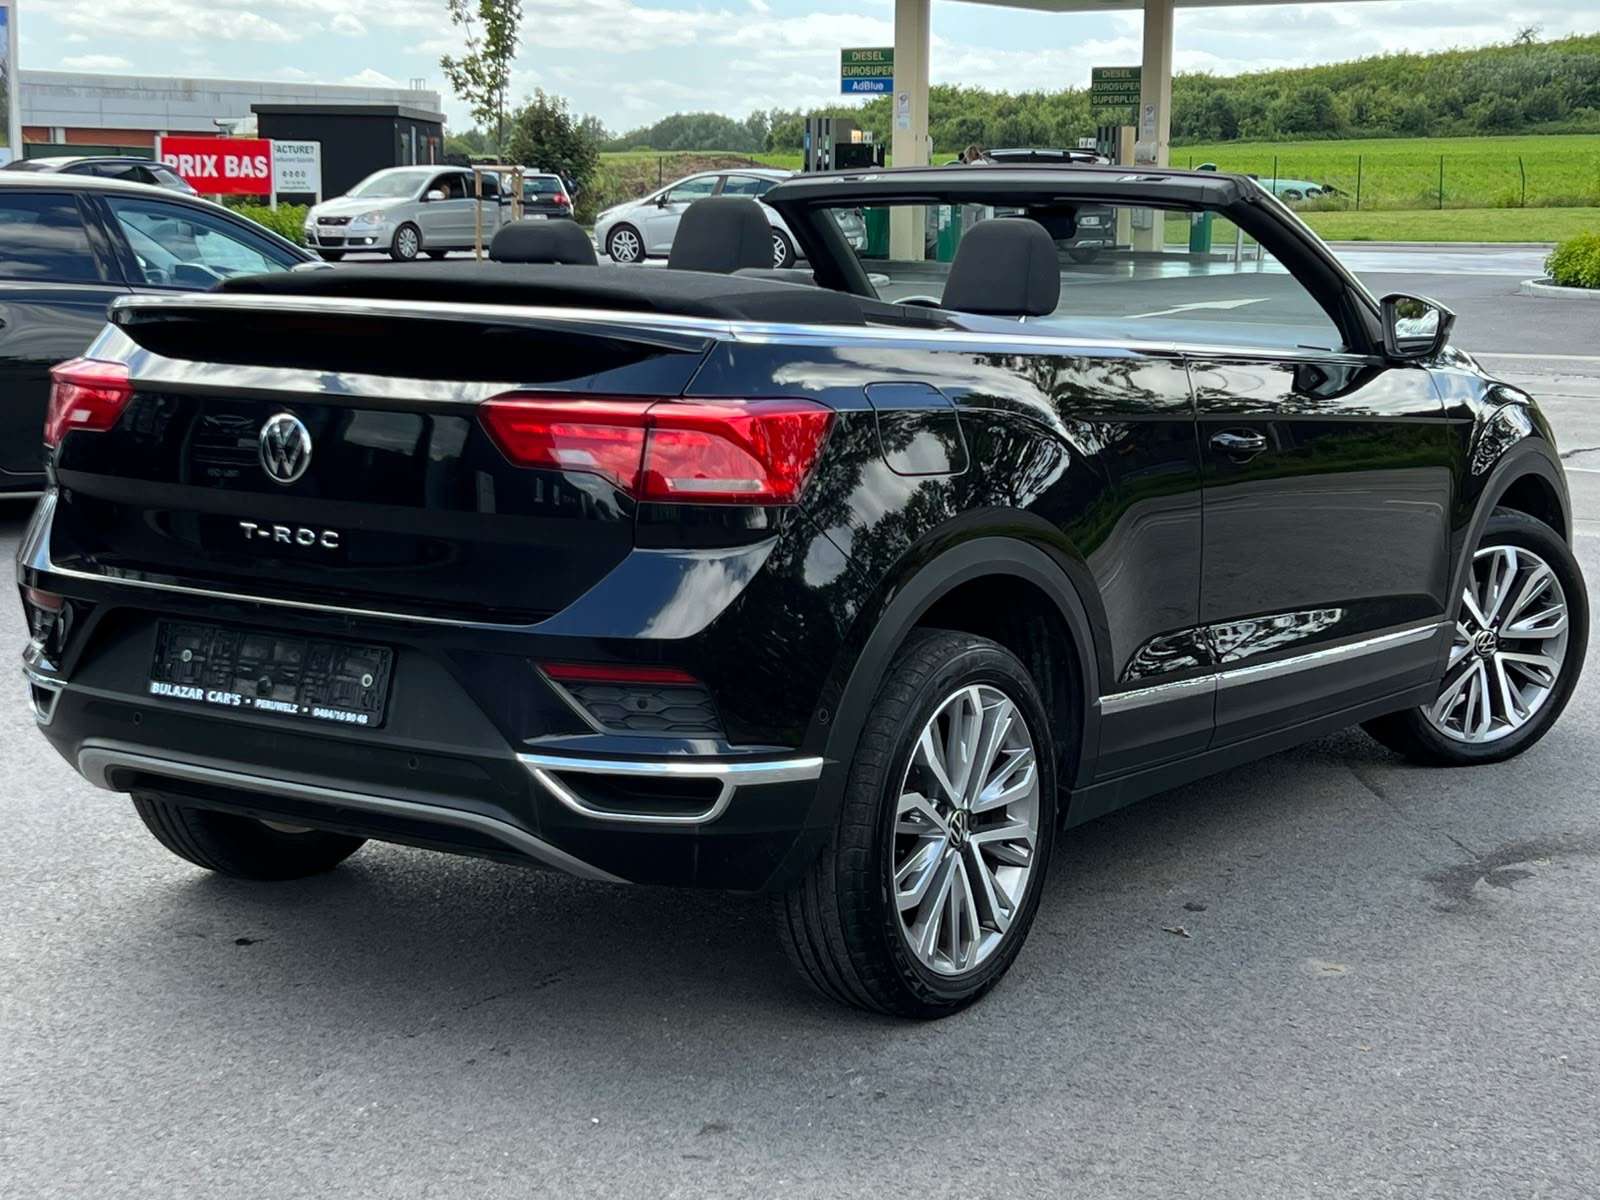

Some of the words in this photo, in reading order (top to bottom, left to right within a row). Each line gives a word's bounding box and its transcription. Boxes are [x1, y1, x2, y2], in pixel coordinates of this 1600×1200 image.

[851, 50, 885, 61] DIESEL
[1102, 69, 1132, 78] DIESEL
[852, 81, 885, 91] AdBlue
[274, 144, 314, 155] ACTURE?
[163, 153, 219, 178] PRIX
[223, 155, 269, 179] BAS
[239, 521, 340, 548] T-ROC
[150, 681, 204, 701] BULAZAR
[206, 690, 242, 706] CAR'S
